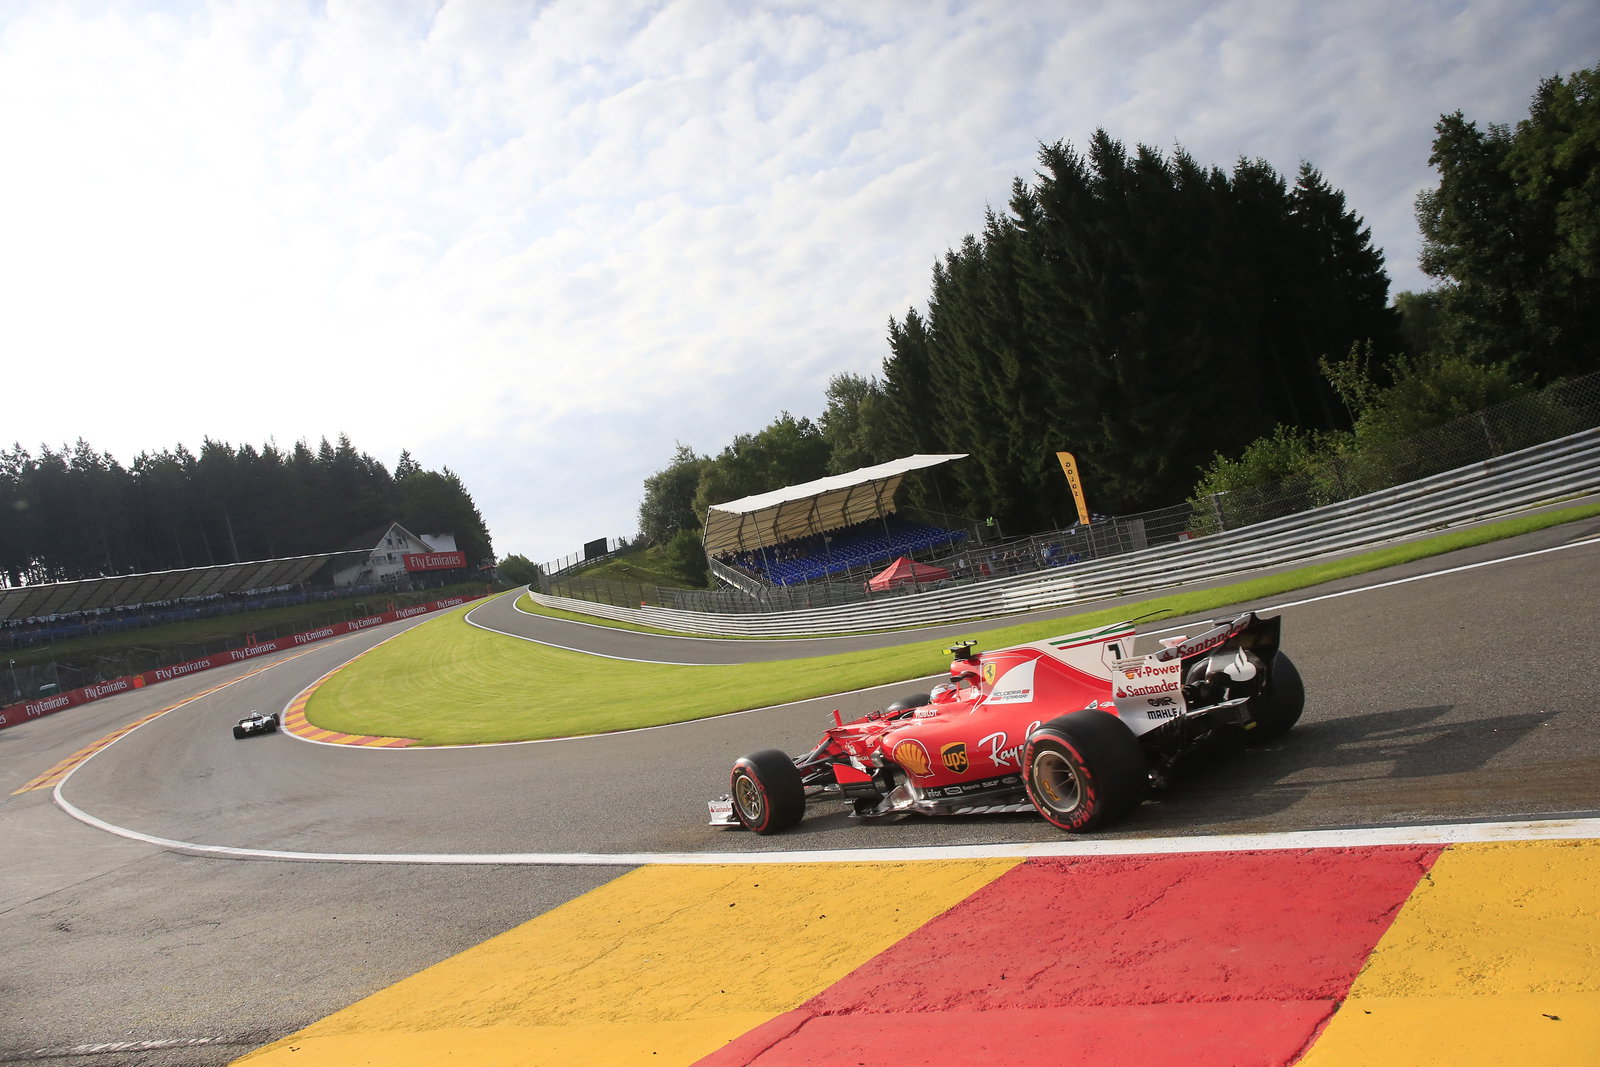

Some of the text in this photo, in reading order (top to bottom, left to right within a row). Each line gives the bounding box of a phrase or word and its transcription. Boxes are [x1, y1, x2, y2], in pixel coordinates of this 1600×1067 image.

[410, 554, 461, 569] Fly Emirates
[348, 616, 382, 630] Fly Emirates
[295, 628, 333, 643] Fly Emirates
[1176, 621, 1248, 661] Santander
[231, 643, 277, 659] Fly Emirates
[156, 659, 210, 680] Fly Emirates
[1135, 664, 1180, 679] V-Power
[84, 681, 127, 699] Fly Emirates
[1126, 679, 1179, 698] Santander
[25, 696, 69, 716] Fly Emirates
[1147, 708, 1178, 720] MAHLE
[943, 752, 967, 770] ups
